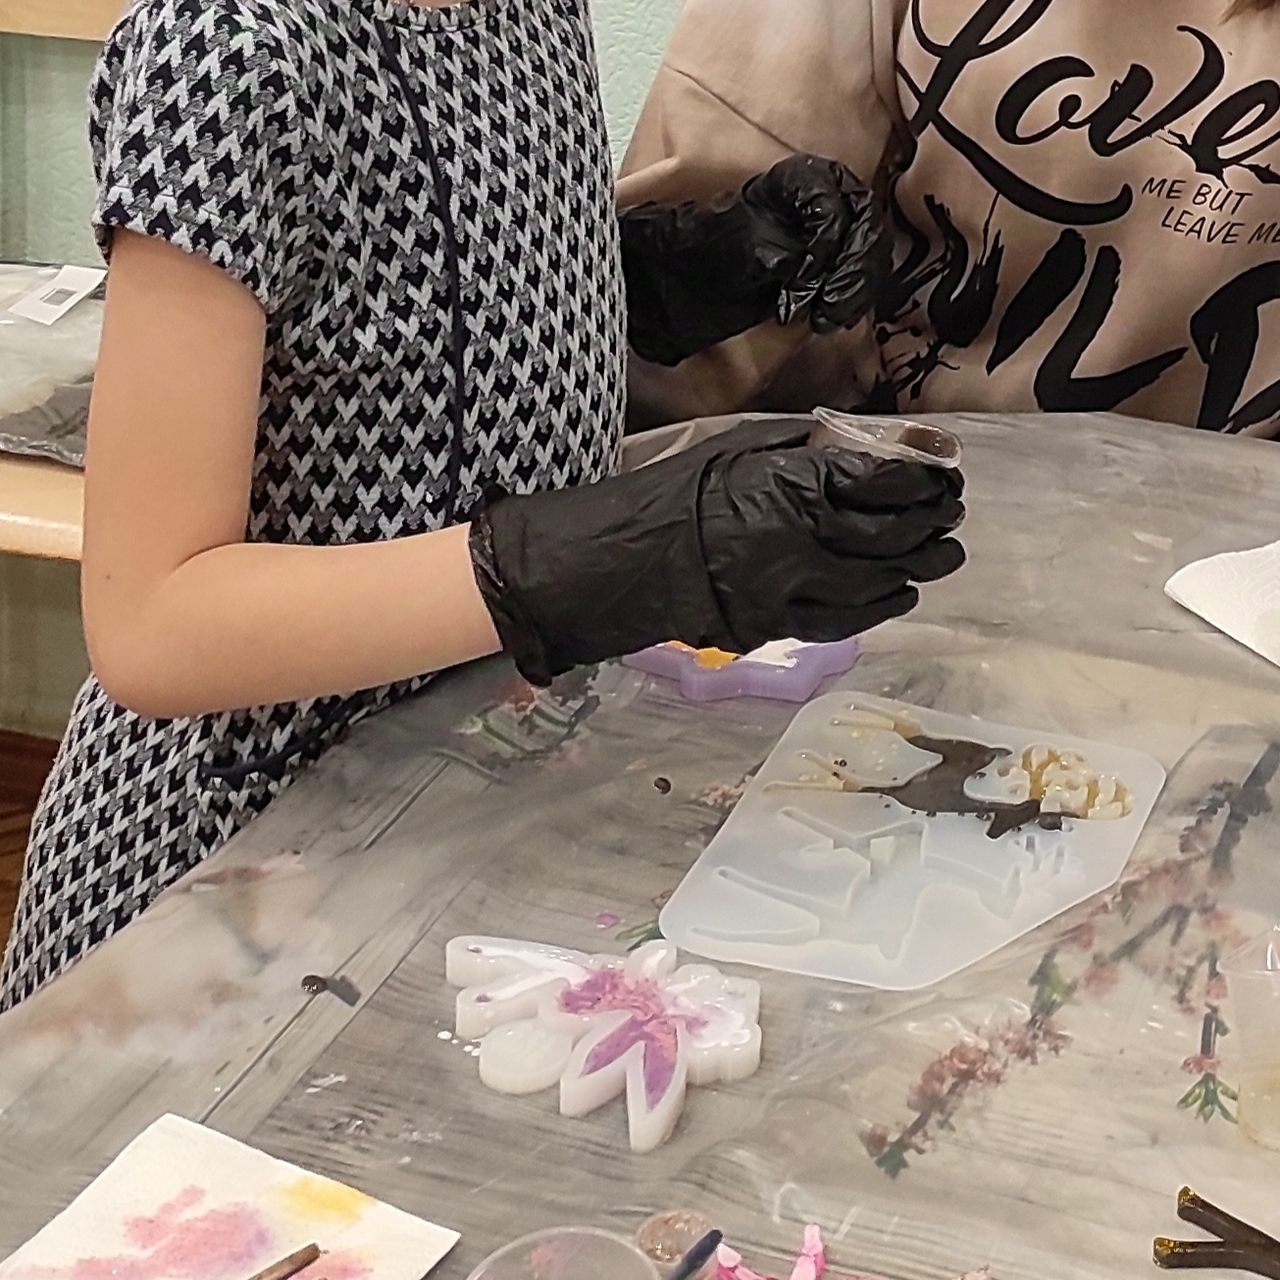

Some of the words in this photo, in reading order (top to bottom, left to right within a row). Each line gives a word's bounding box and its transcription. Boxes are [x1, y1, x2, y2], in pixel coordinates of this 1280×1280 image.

[1141, 177, 1187, 199] ME
[1192, 183, 1253, 215] BUT
[1161, 206, 1246, 244] LEAVE
